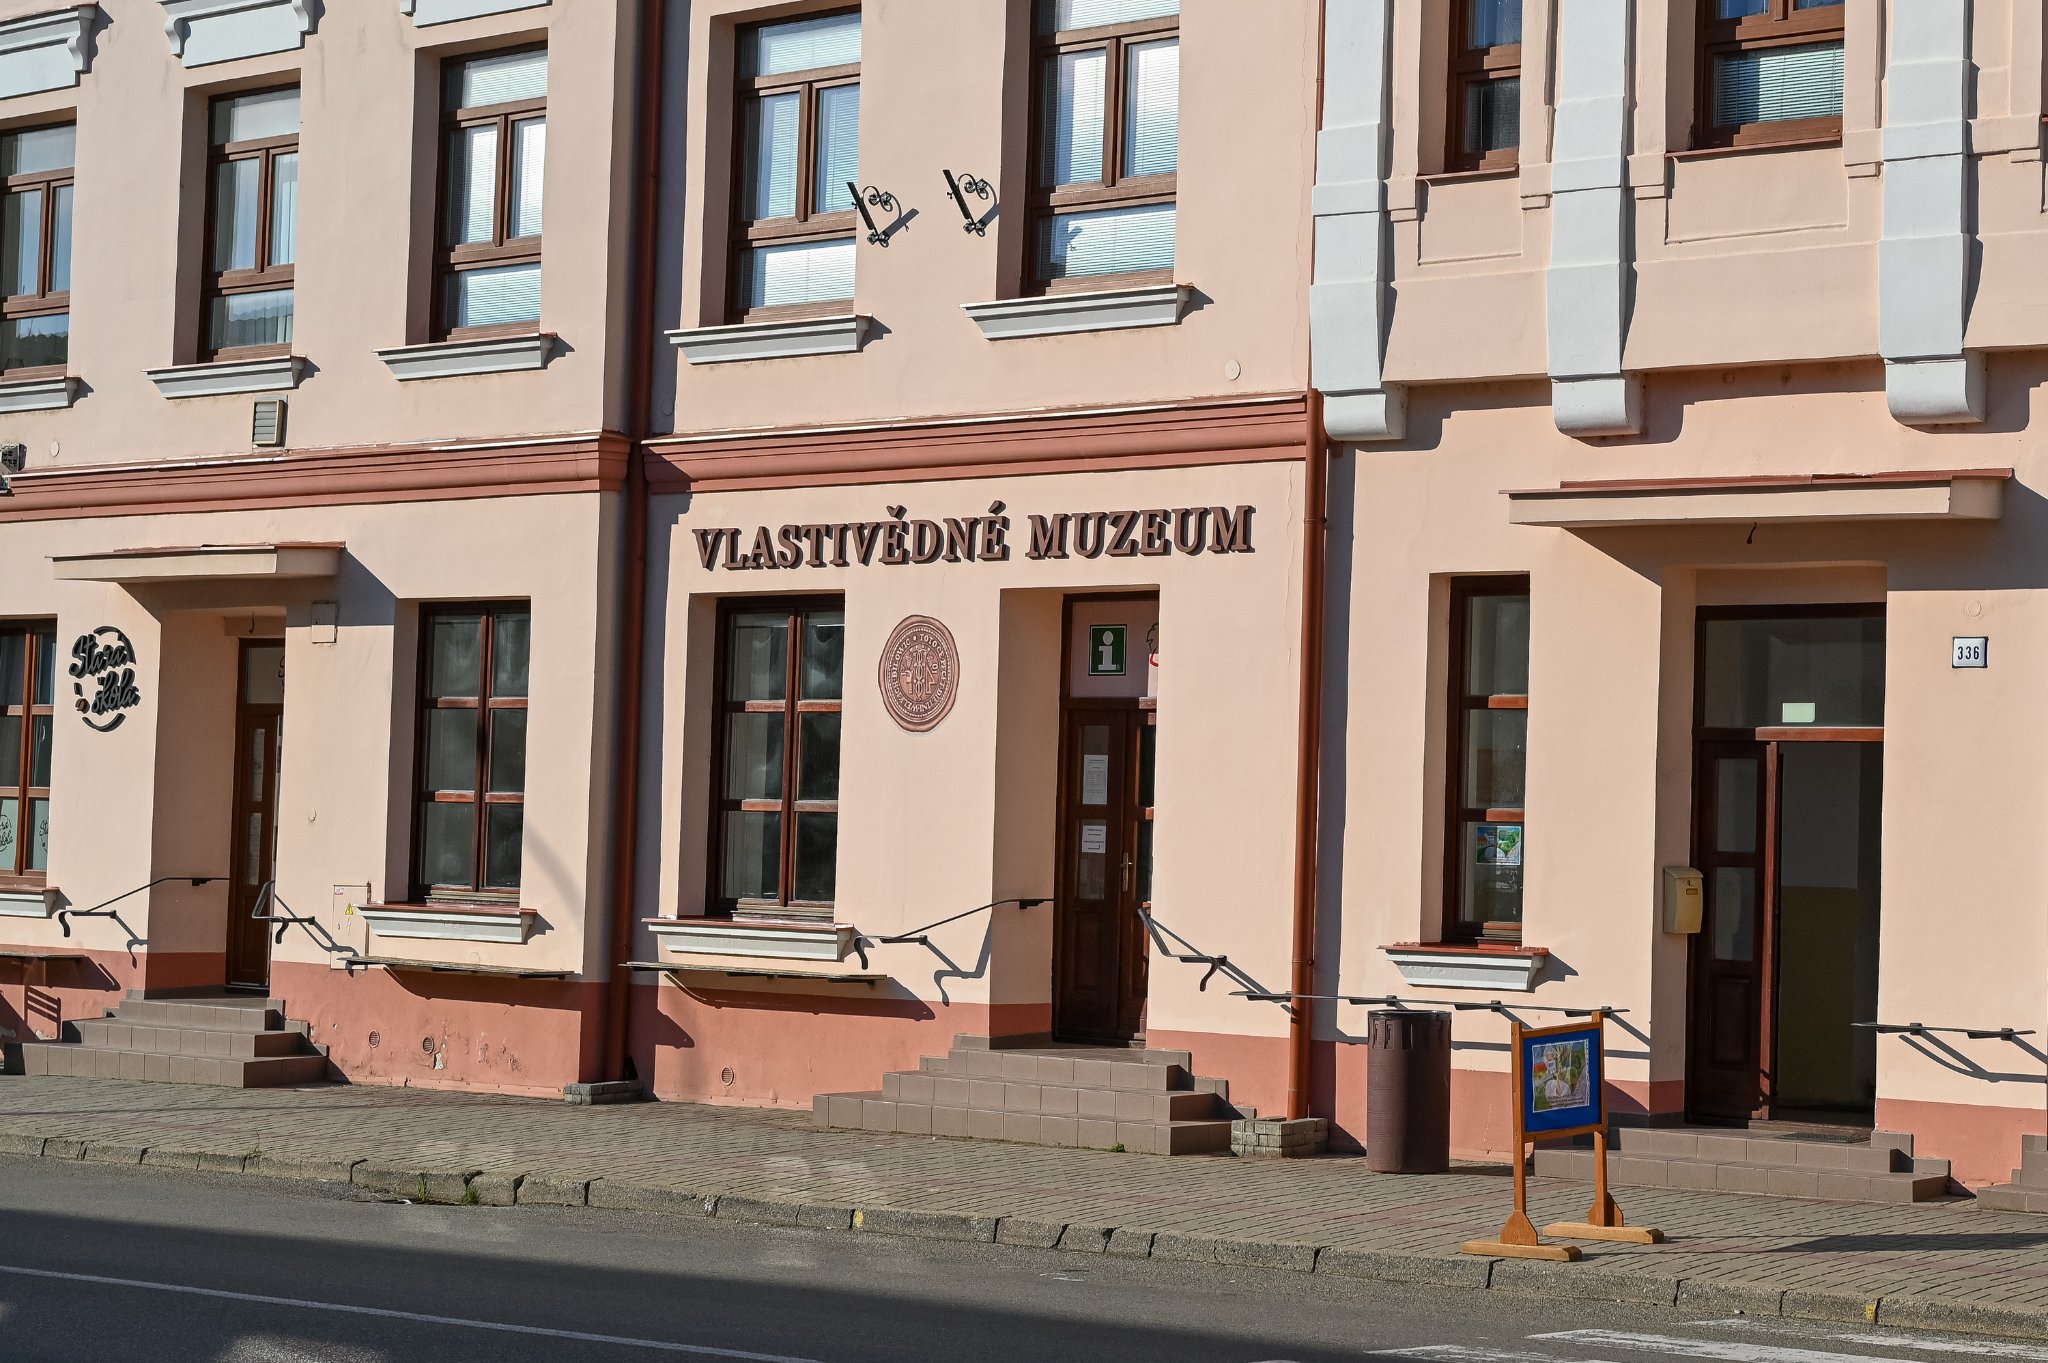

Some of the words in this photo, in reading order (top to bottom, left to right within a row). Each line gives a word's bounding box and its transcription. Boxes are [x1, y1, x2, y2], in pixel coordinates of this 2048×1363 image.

[691, 499, 1011, 572] VLASTIVĚDNÉ
[1025, 504, 1257, 560] MUZEUM
[1957, 645, 1980, 660] 336
